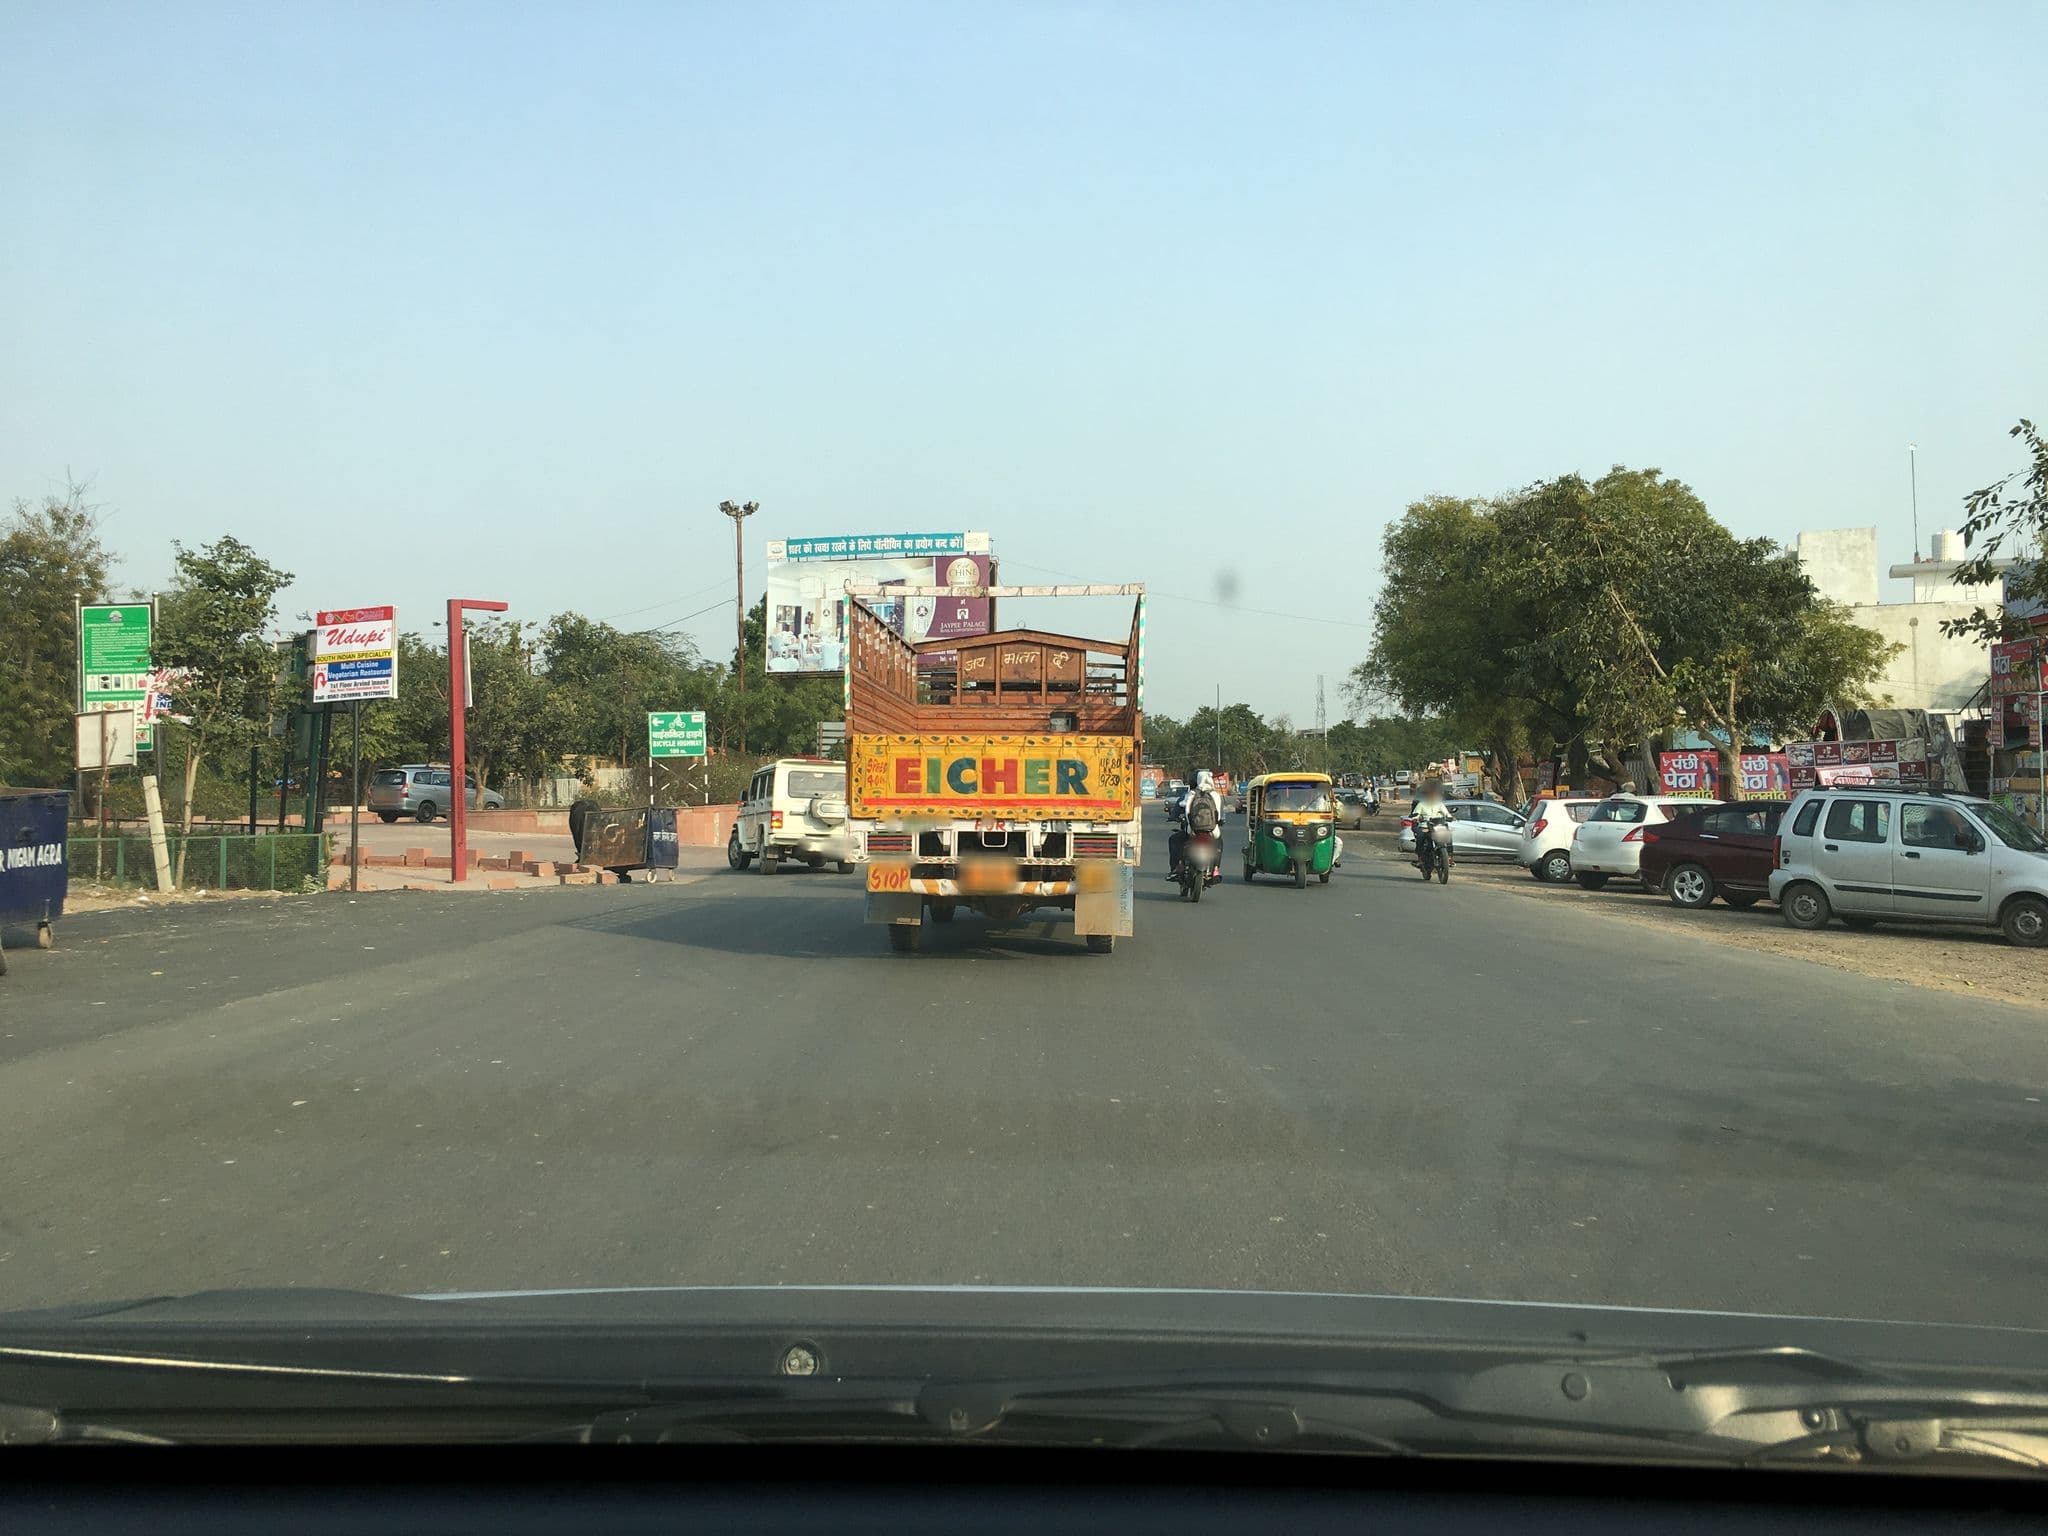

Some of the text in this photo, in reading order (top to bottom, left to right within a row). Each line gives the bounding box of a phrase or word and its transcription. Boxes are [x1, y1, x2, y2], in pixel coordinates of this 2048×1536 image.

[803, 541, 812, 554] को
[940, 620, 986, 630] JAYPEE PALACE
[326, 628, 386, 648] Udupi
[336, 653, 356, 661] INDIAN
[357, 650, 391, 659] SPECIALITY
[356, 660, 379, 669] Cuisine
[965, 656, 987, 672] जय
[328, 667, 392, 680] Vegetarian Restaurant
[652, 739, 702, 748] BICYCLE HIGHWAY
[1672, 753, 1699, 771] पंछी
[1741, 755, 1769, 772] पंछी
[896, 757, 1090, 795] EICHER
[1663, 767, 1698, 789] पेठा
[36, 842, 62, 866] AGRA
[870, 867, 909, 890] STOP
